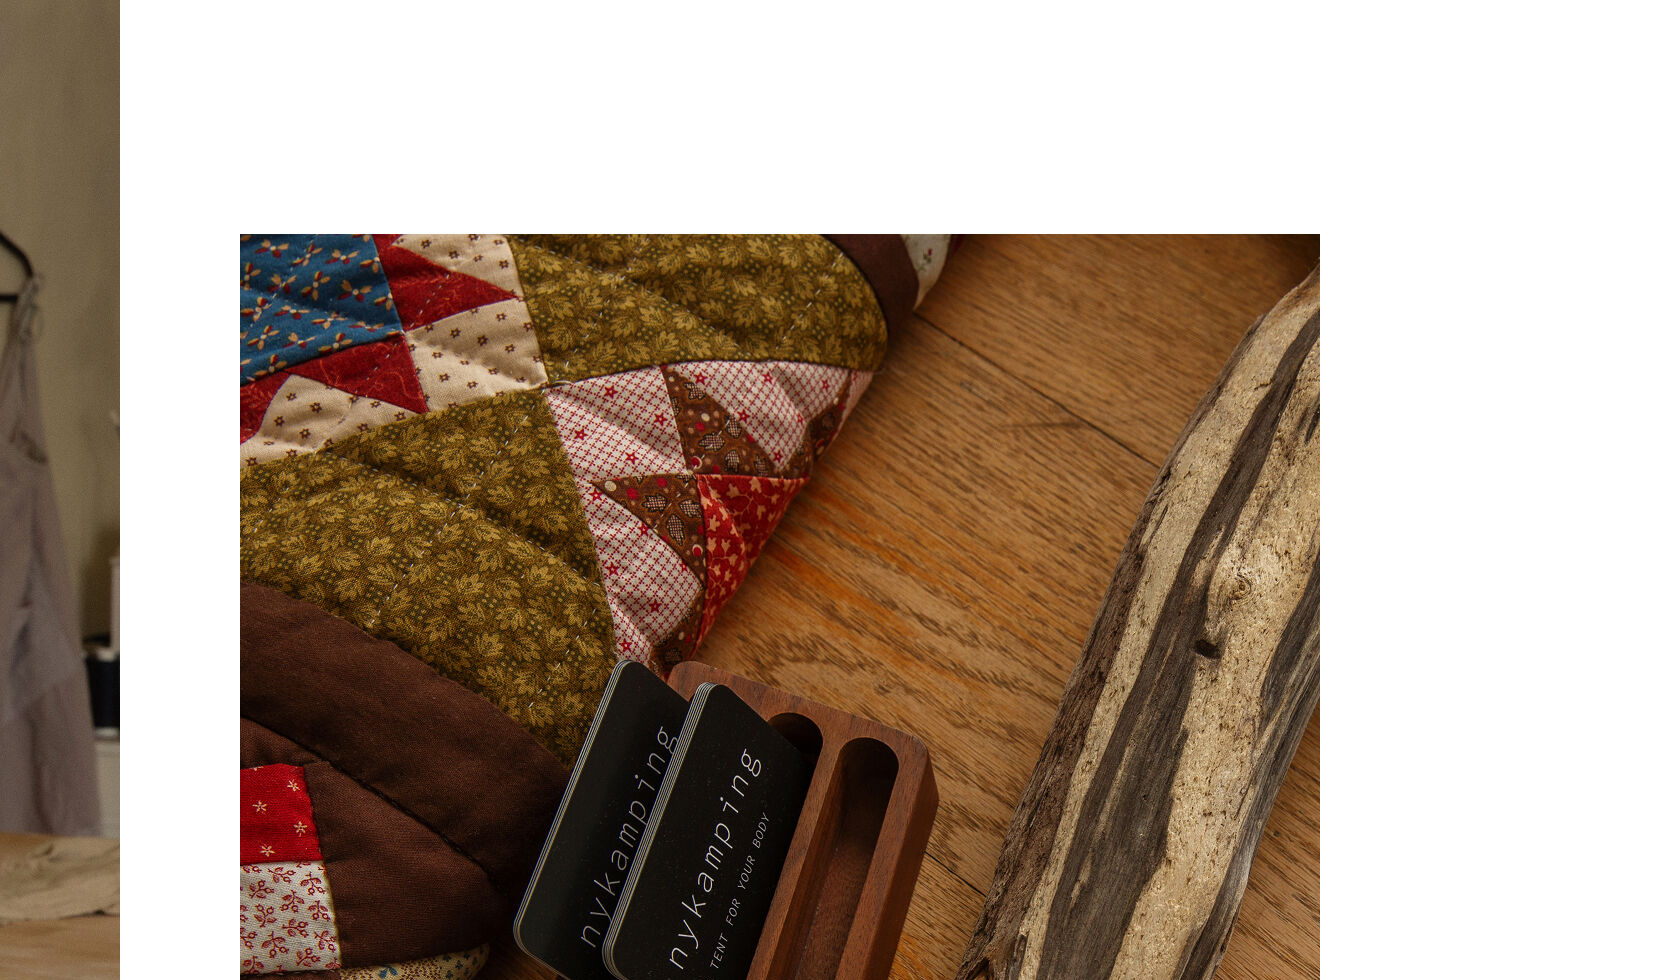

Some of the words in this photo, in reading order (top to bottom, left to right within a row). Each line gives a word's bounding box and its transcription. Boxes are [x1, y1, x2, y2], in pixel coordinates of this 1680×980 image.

[580, 725, 679, 949] nykamping
[669, 748, 762, 970] nykamping
[709, 934, 729, 970] TENT
[725, 898, 741, 927] FOR
[737, 854, 756, 890] YOUR
[752, 812, 770, 849] BODY
